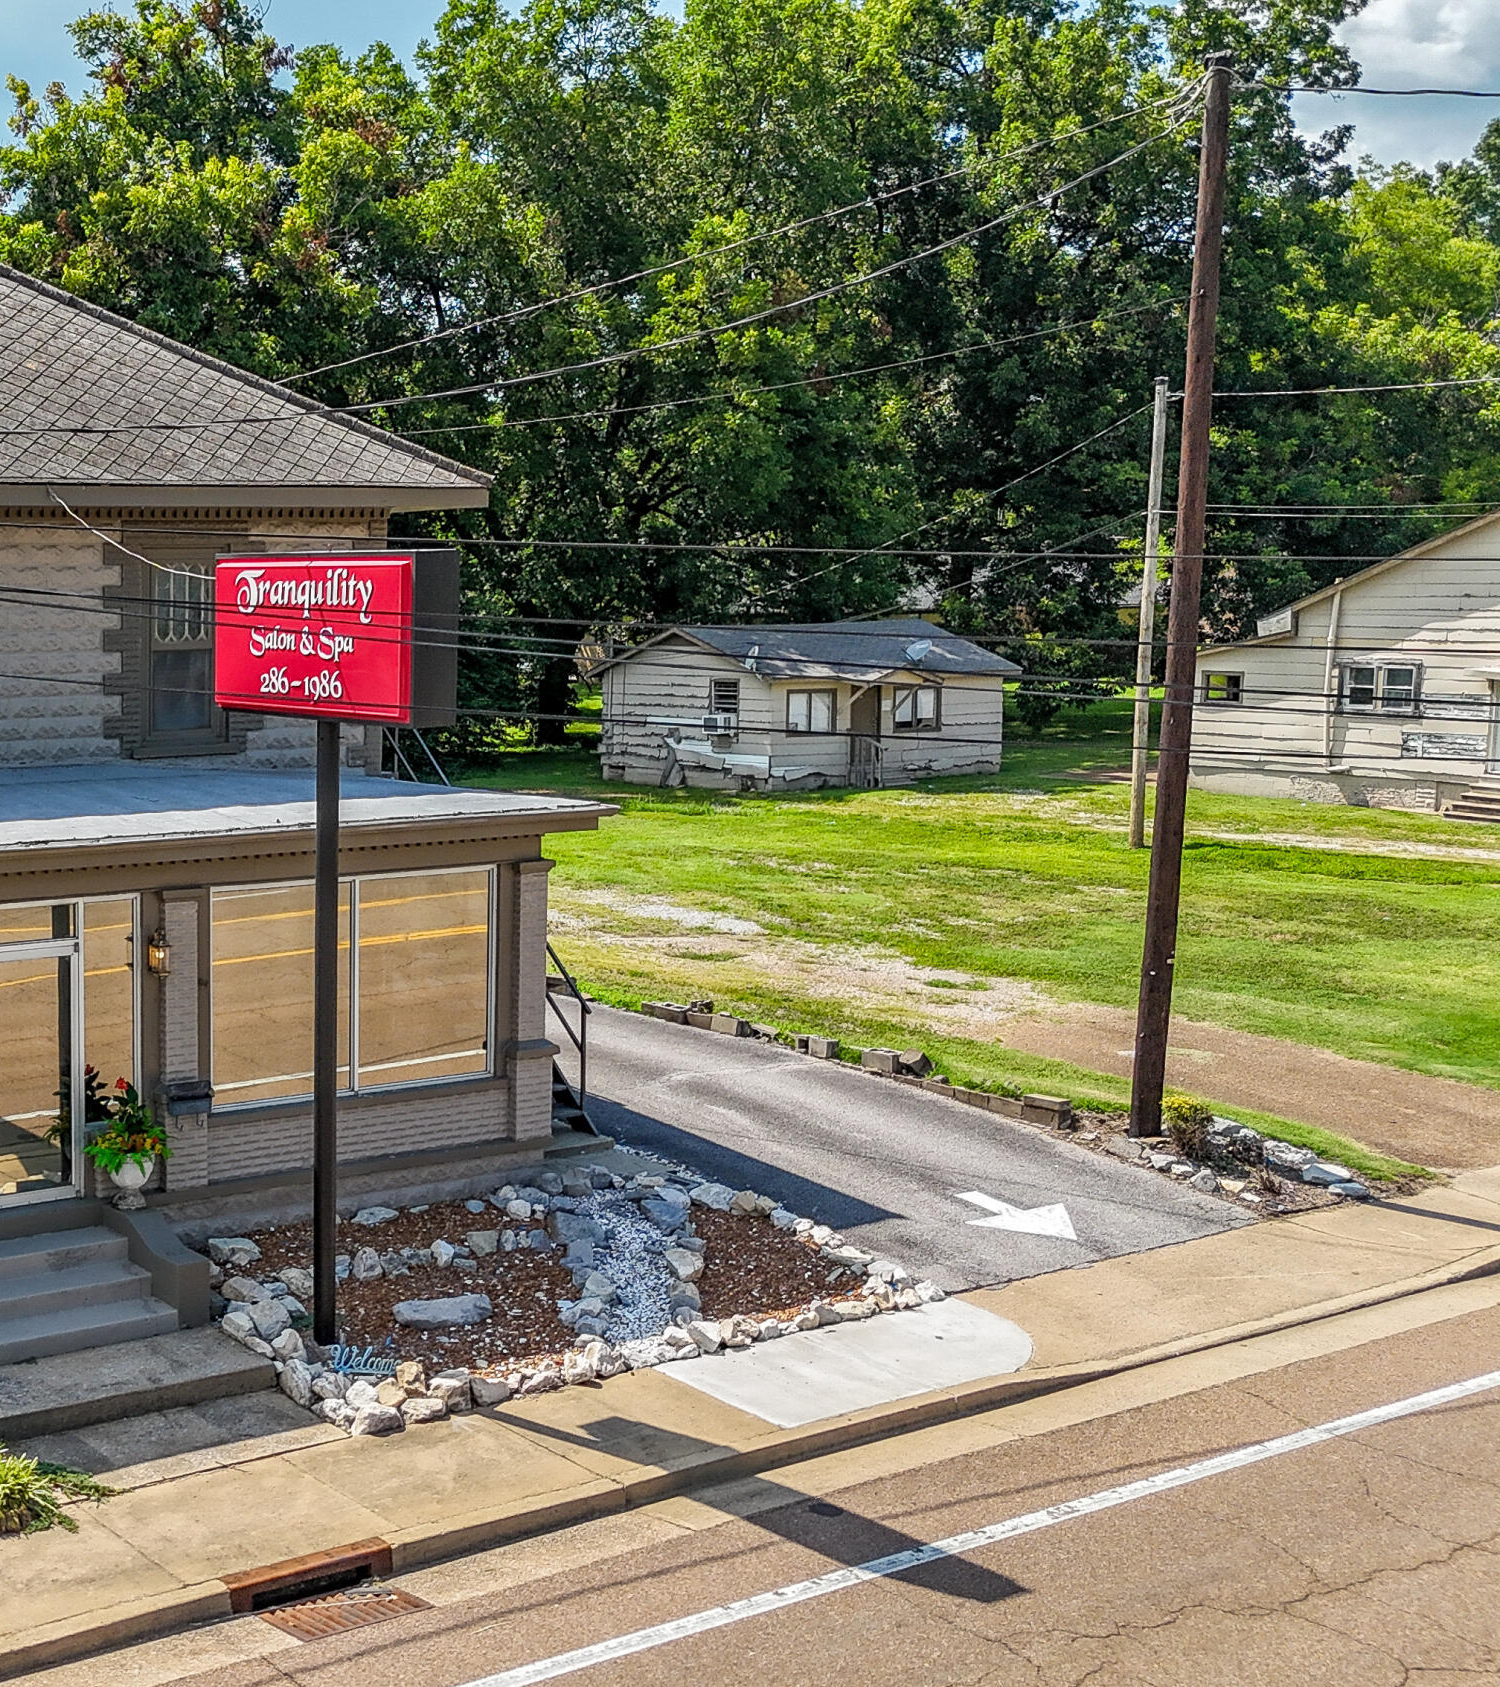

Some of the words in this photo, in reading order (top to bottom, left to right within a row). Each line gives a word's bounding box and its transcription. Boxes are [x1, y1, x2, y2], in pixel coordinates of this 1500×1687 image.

[234, 568, 373, 624] Tranquility
[249, 626, 297, 657] Salon
[299, 626, 316, 656] &
[317, 627, 355, 662] Spa
[260, 666, 343, 704] 286-1986
